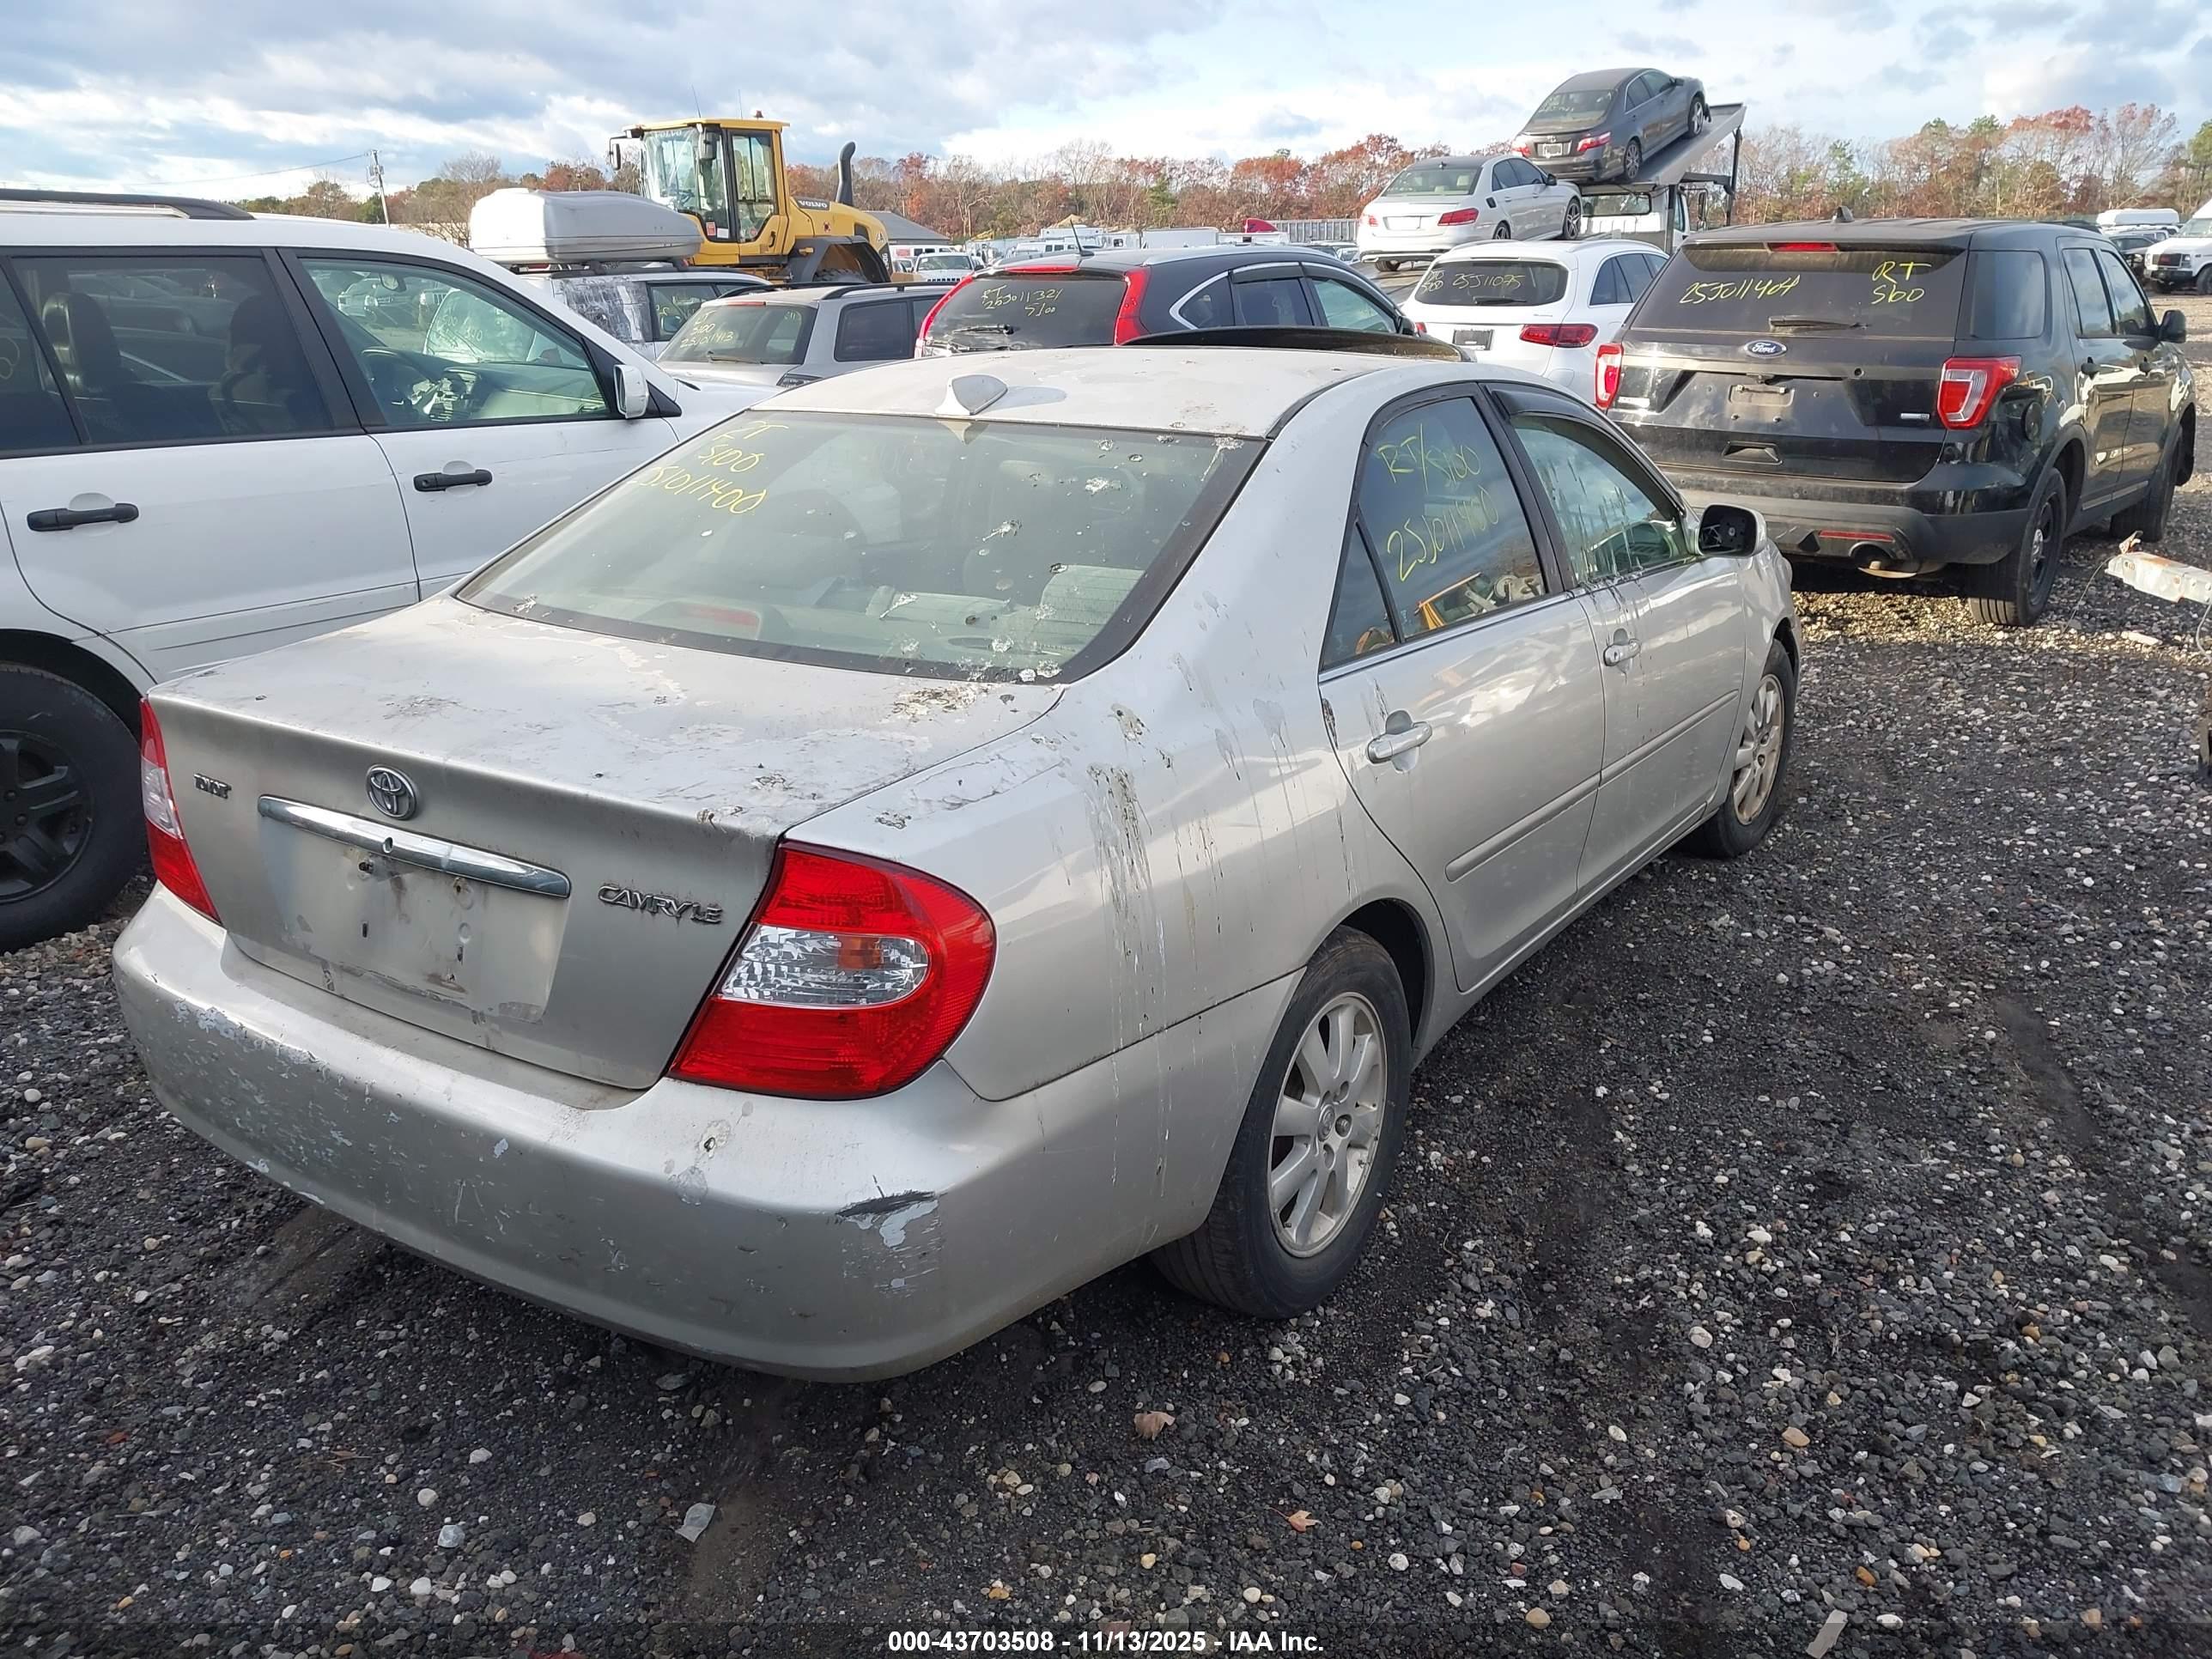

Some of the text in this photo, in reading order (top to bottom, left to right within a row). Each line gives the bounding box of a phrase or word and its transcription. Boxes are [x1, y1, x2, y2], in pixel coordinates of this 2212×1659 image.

[799, 199, 829, 209] VOLVO
[1872, 260, 1932, 284] RT
[1751, 342, 1777, 354] Ford
[598, 884, 723, 924] CAMRY LE
